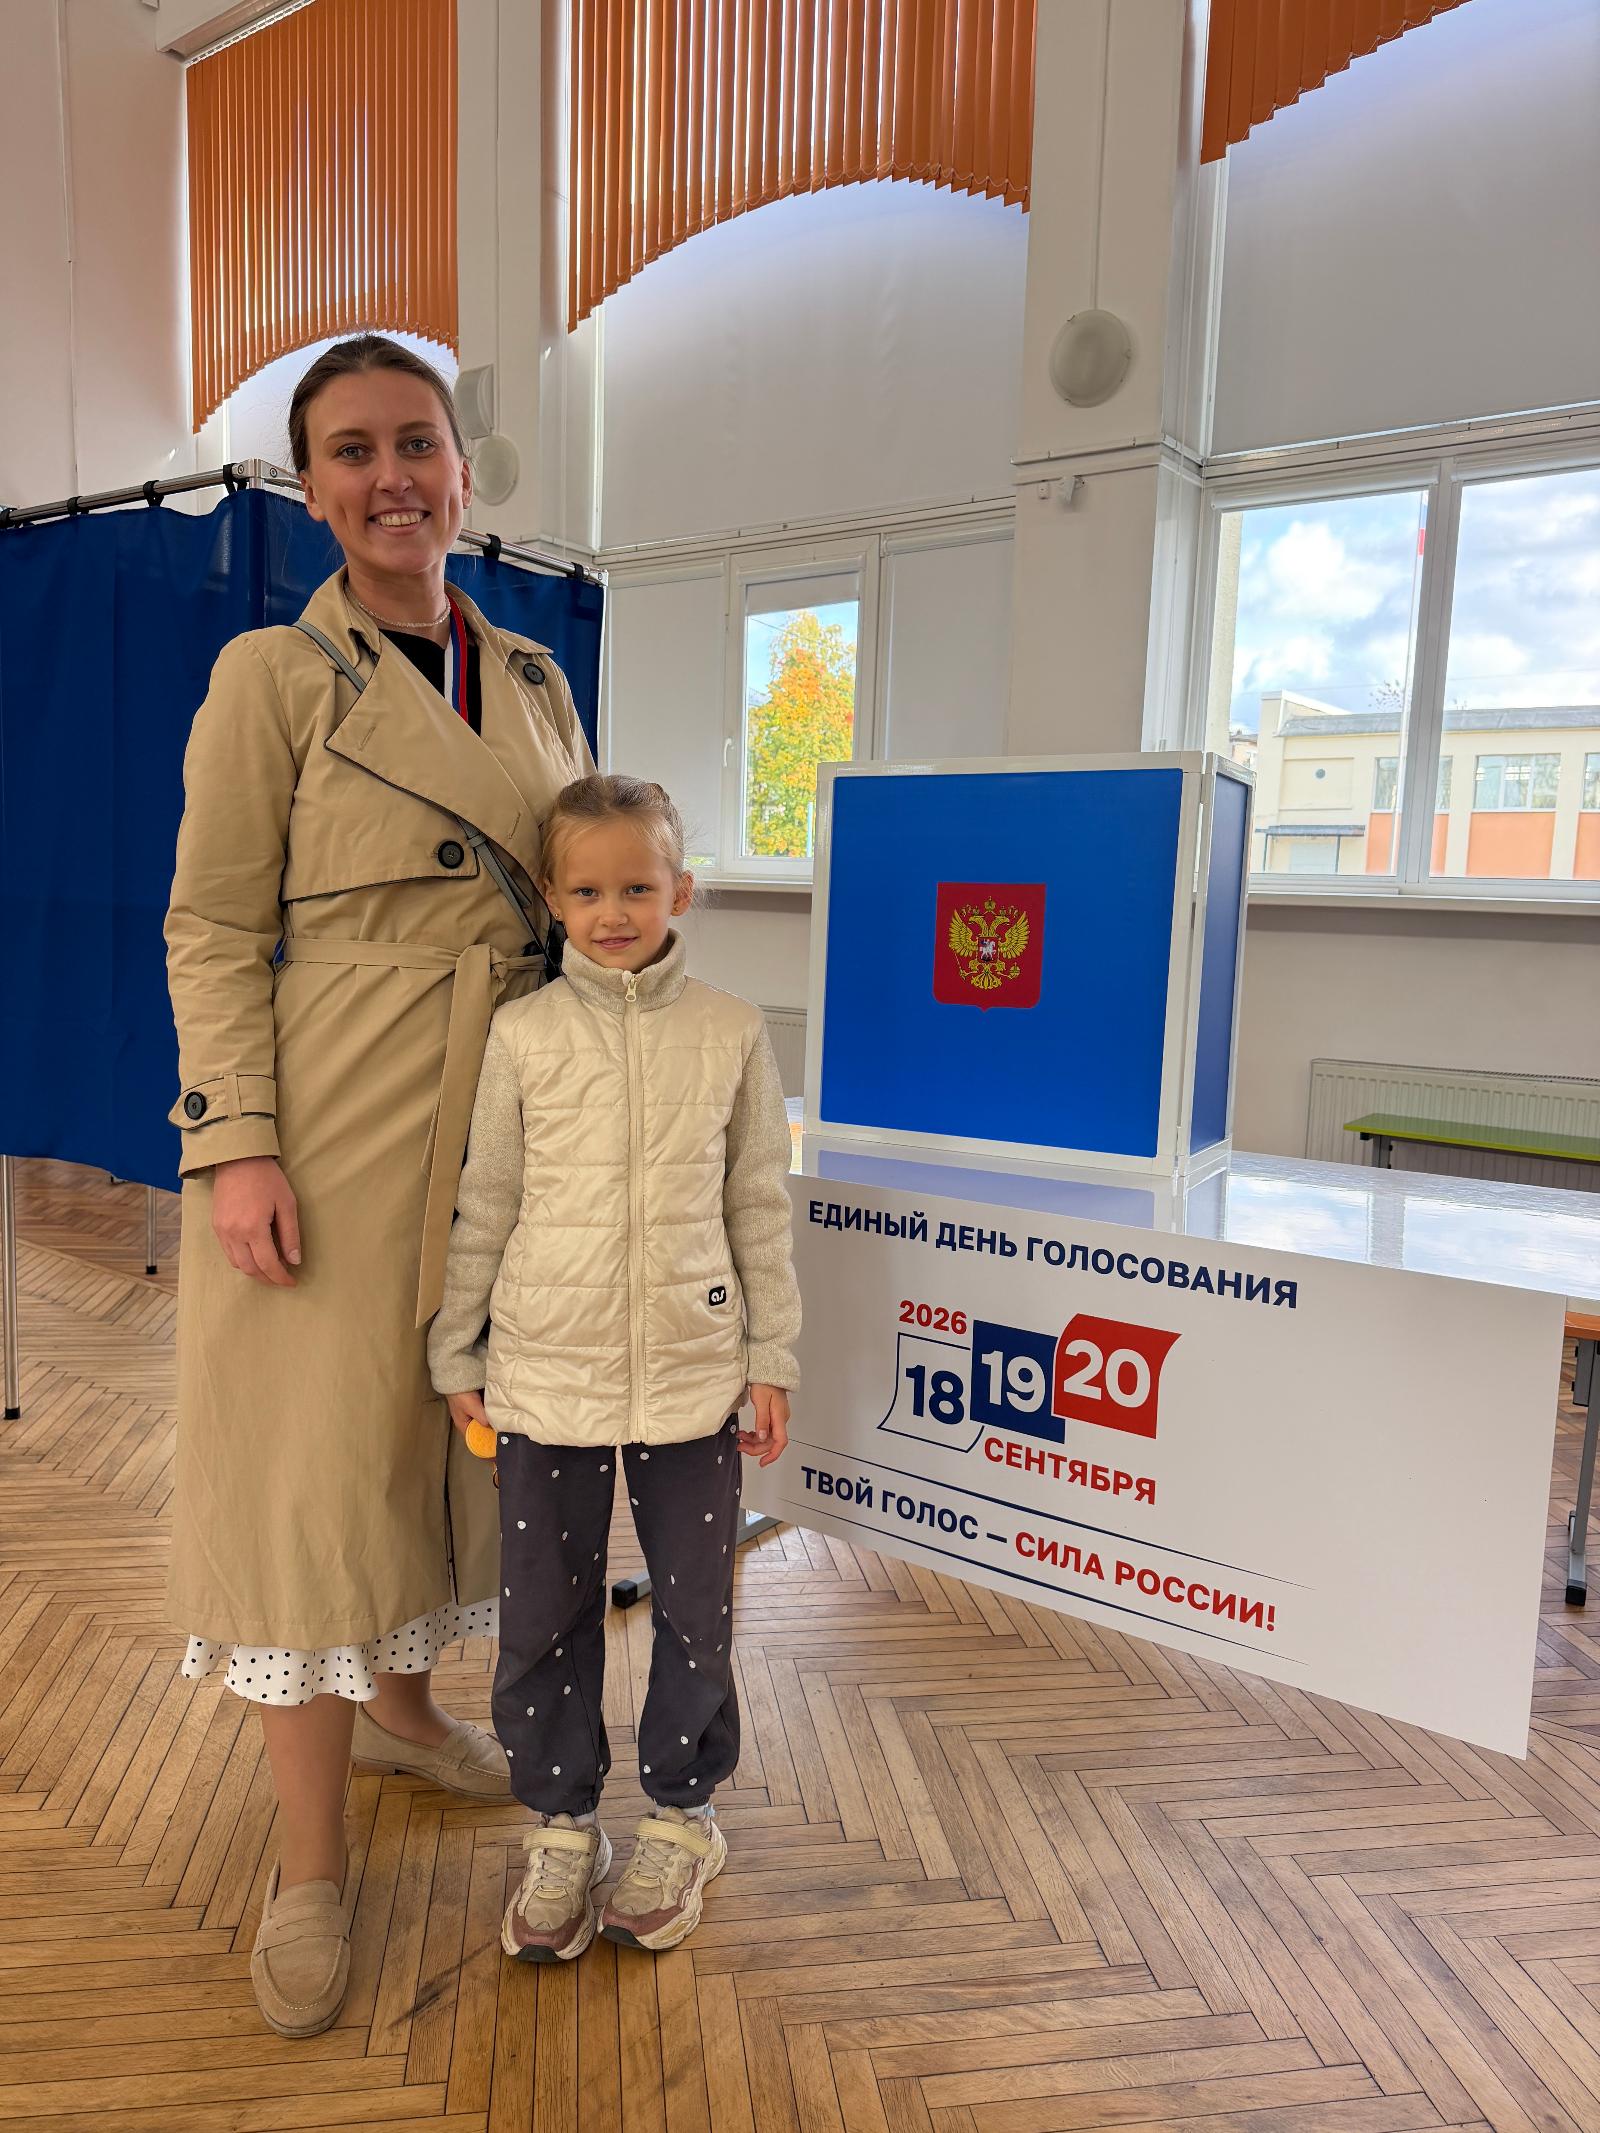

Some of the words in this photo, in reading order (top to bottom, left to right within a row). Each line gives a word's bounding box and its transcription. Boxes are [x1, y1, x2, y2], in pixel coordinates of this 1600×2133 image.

[808, 1199, 928, 1243] ЕДИНЫЙ
[935, 1221, 1018, 1258] ДЕНЬ
[1026, 1236, 1299, 1309] ГОЛОСОВАНИЯ
[898, 1299, 968, 1336] 2026
[905, 1364, 965, 1425] 18
[981, 1350, 1046, 1414] 19
[1063, 1339, 1151, 1409] 20
[983, 1436, 1157, 1505] СЕНТЯБРЯ
[800, 1465, 873, 1509] ТВОЙ
[881, 1489, 979, 1540] ГОЛОС
[1014, 1531, 1105, 1581] СИЛА
[1114, 1560, 1276, 1632] РОССИИ!
